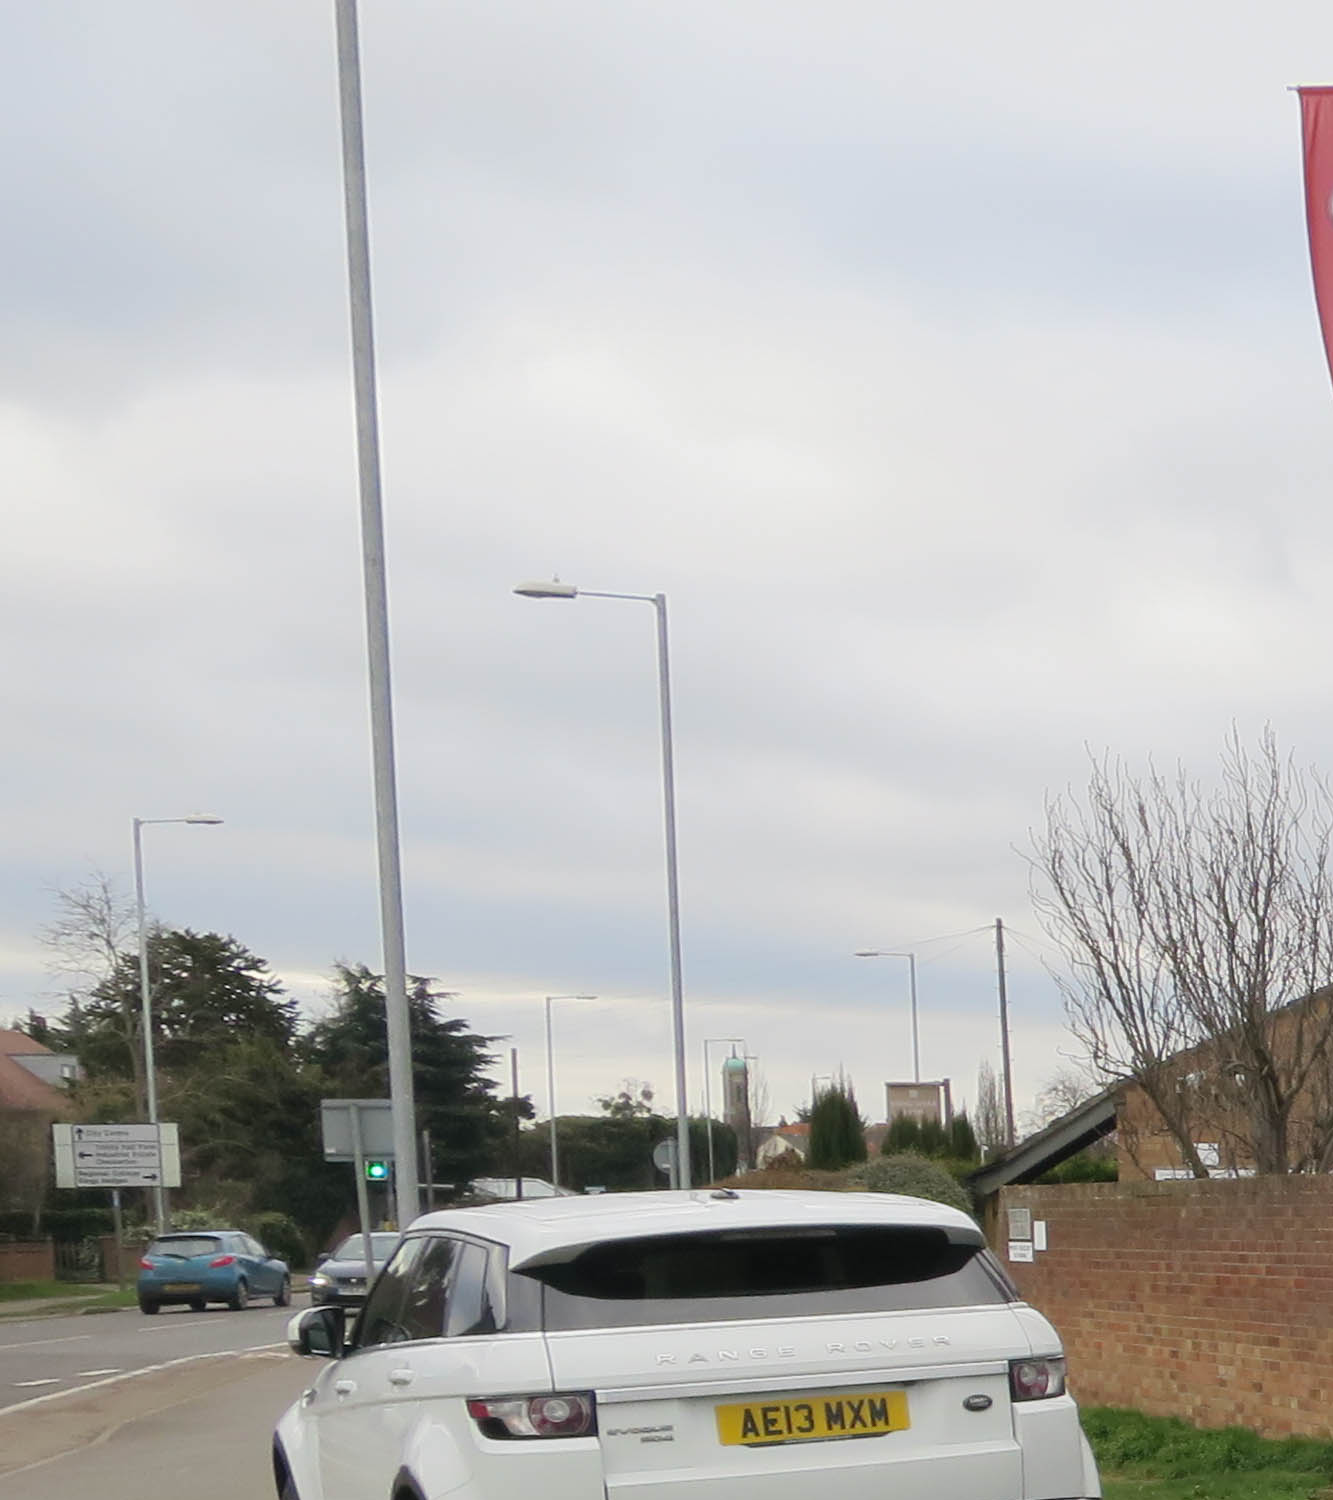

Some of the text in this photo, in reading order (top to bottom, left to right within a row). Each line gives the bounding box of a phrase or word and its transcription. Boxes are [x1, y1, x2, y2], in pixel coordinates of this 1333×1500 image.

[655, 1335, 952, 1366] RANGE ROVER
[741, 1398, 890, 1439] AE13 MXM
